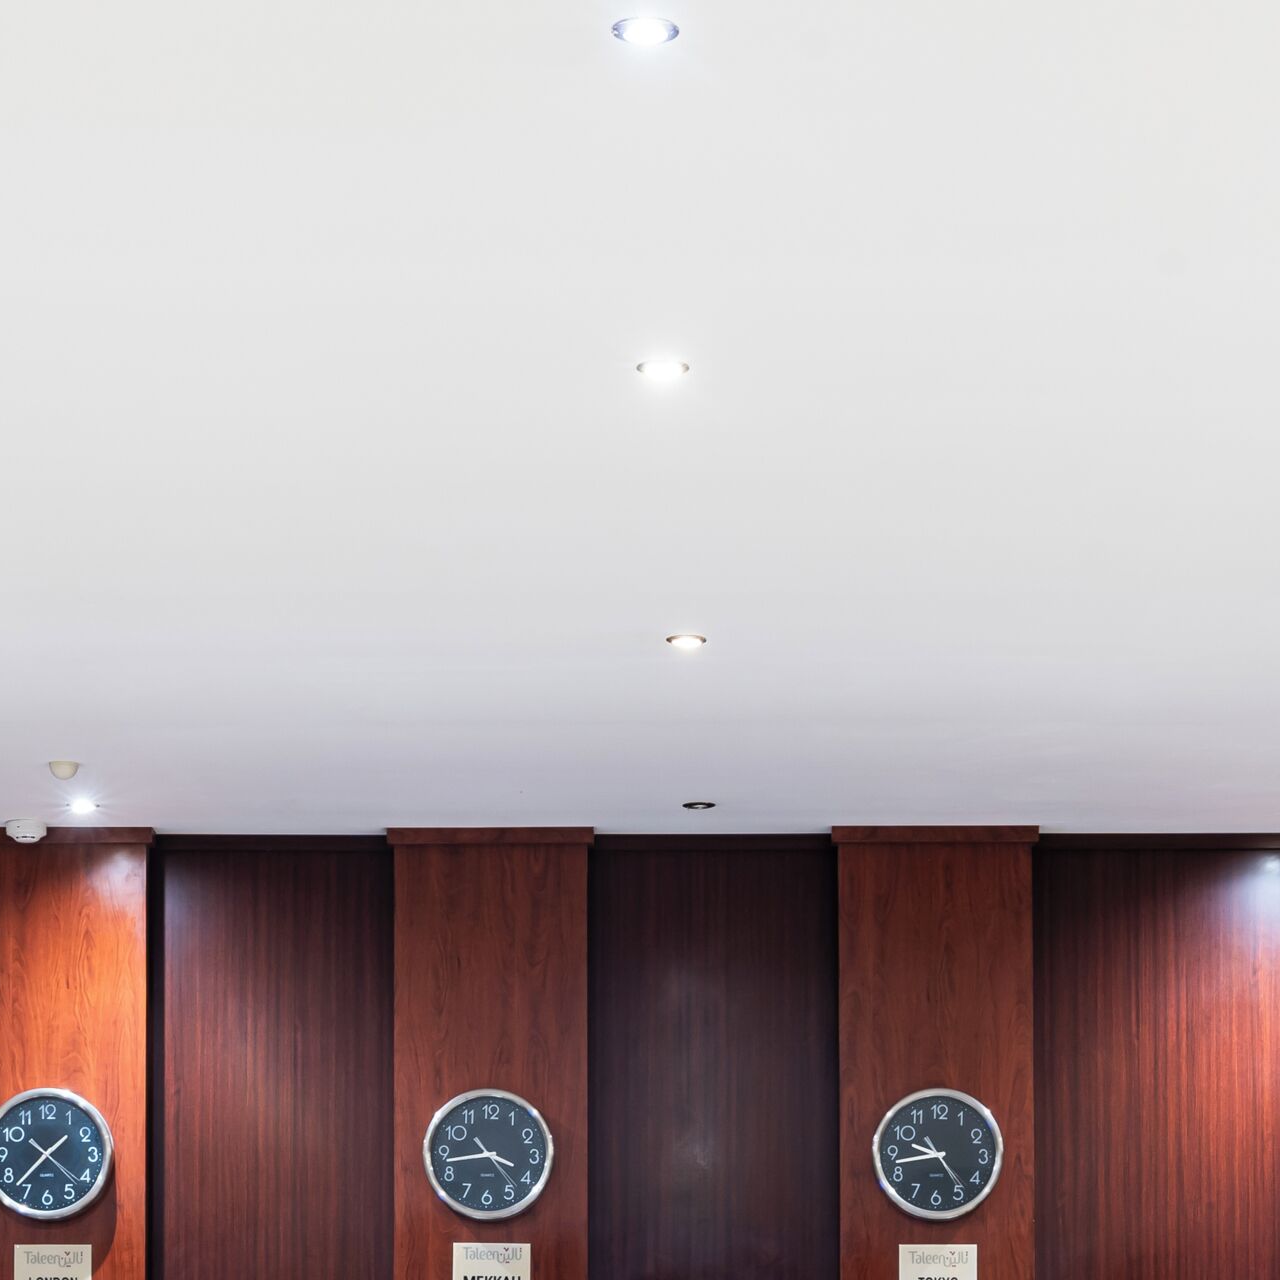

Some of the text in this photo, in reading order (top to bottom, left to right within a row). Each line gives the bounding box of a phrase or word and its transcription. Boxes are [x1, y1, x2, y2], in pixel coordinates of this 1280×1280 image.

[19, 1110, 31, 1125] 11
[39, 1104, 56, 1120] 12
[66, 1111, 71, 1125] 1
[462, 1109, 474, 1124] 11
[482, 1105, 499, 1120] 12
[509, 1111, 514, 1126] 1
[911, 1109, 923, 1124] 11
[931, 1104, 948, 1120] 12
[958, 1111, 963, 1126] 1
[3, 1127, 25, 1142] 10
[80, 1127, 91, 1142] 2
[445, 1125, 467, 1141] 10
[522, 1128, 533, 1144] 2
[894, 1126, 915, 1141] 10
[971, 1128, 982, 1144] 2
[88, 1147, 98, 1162] 3
[439, 1145, 449, 1160] 9
[529, 1149, 539, 1164] 3
[887, 1145, 898, 1160] 9
[978, 1149, 988, 1164] 3
[4, 1168, 13, 1183] 8
[80, 1168, 90, 1183] 4
[444, 1166, 454, 1181] 8
[520, 1171, 531, 1184] 4
[893, 1167, 903, 1181] 8
[970, 1171, 980, 1184] 4
[22, 1184, 31, 1199] 7
[42, 1190, 53, 1205] 6
[64, 1184, 74, 1199] 5
[462, 1184, 471, 1198] 7
[482, 1190, 492, 1204] 6
[504, 1185, 514, 1200] 5
[912, 1184, 920, 1198] 7
[931, 1190, 941, 1205] 6
[953, 1185, 963, 1200] 5
[24, 1251, 60, 1264] Taleen
[463, 1247, 499, 1260] Taleen
[908, 1251, 945, 1264] Taleen
